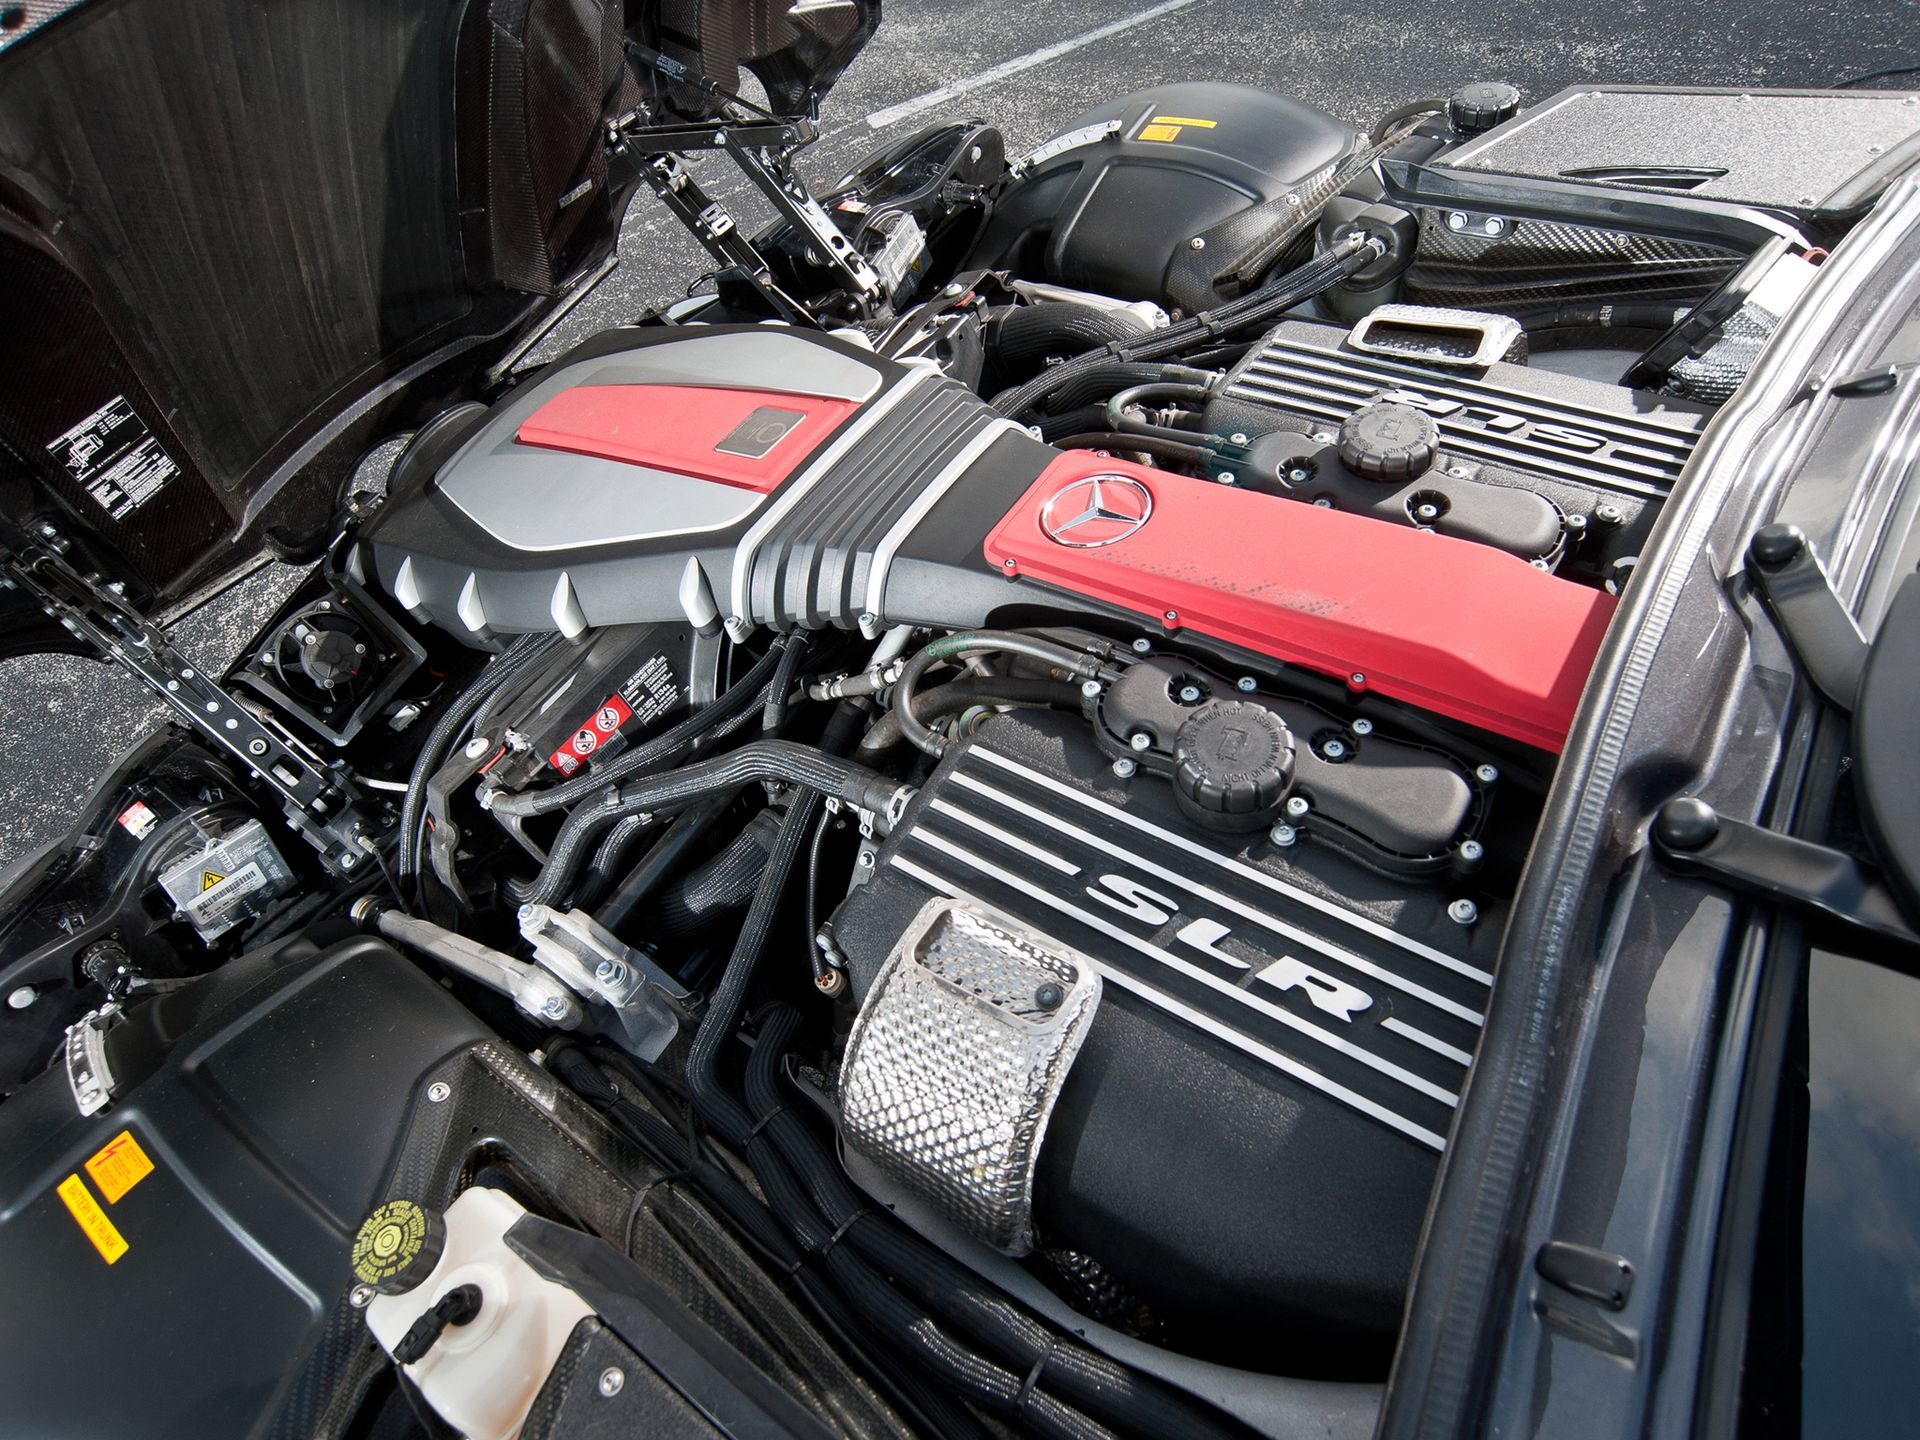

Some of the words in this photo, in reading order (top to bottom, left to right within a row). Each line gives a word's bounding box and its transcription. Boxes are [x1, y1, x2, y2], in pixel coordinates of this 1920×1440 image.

[1384, 389, 1607, 447] SLR
[1086, 874, 1373, 1023] SLR
[67, 1183, 92, 1214] BATTERY
[94, 1220, 118, 1250] TRUNK
[373, 1205, 386, 1218] CAP
